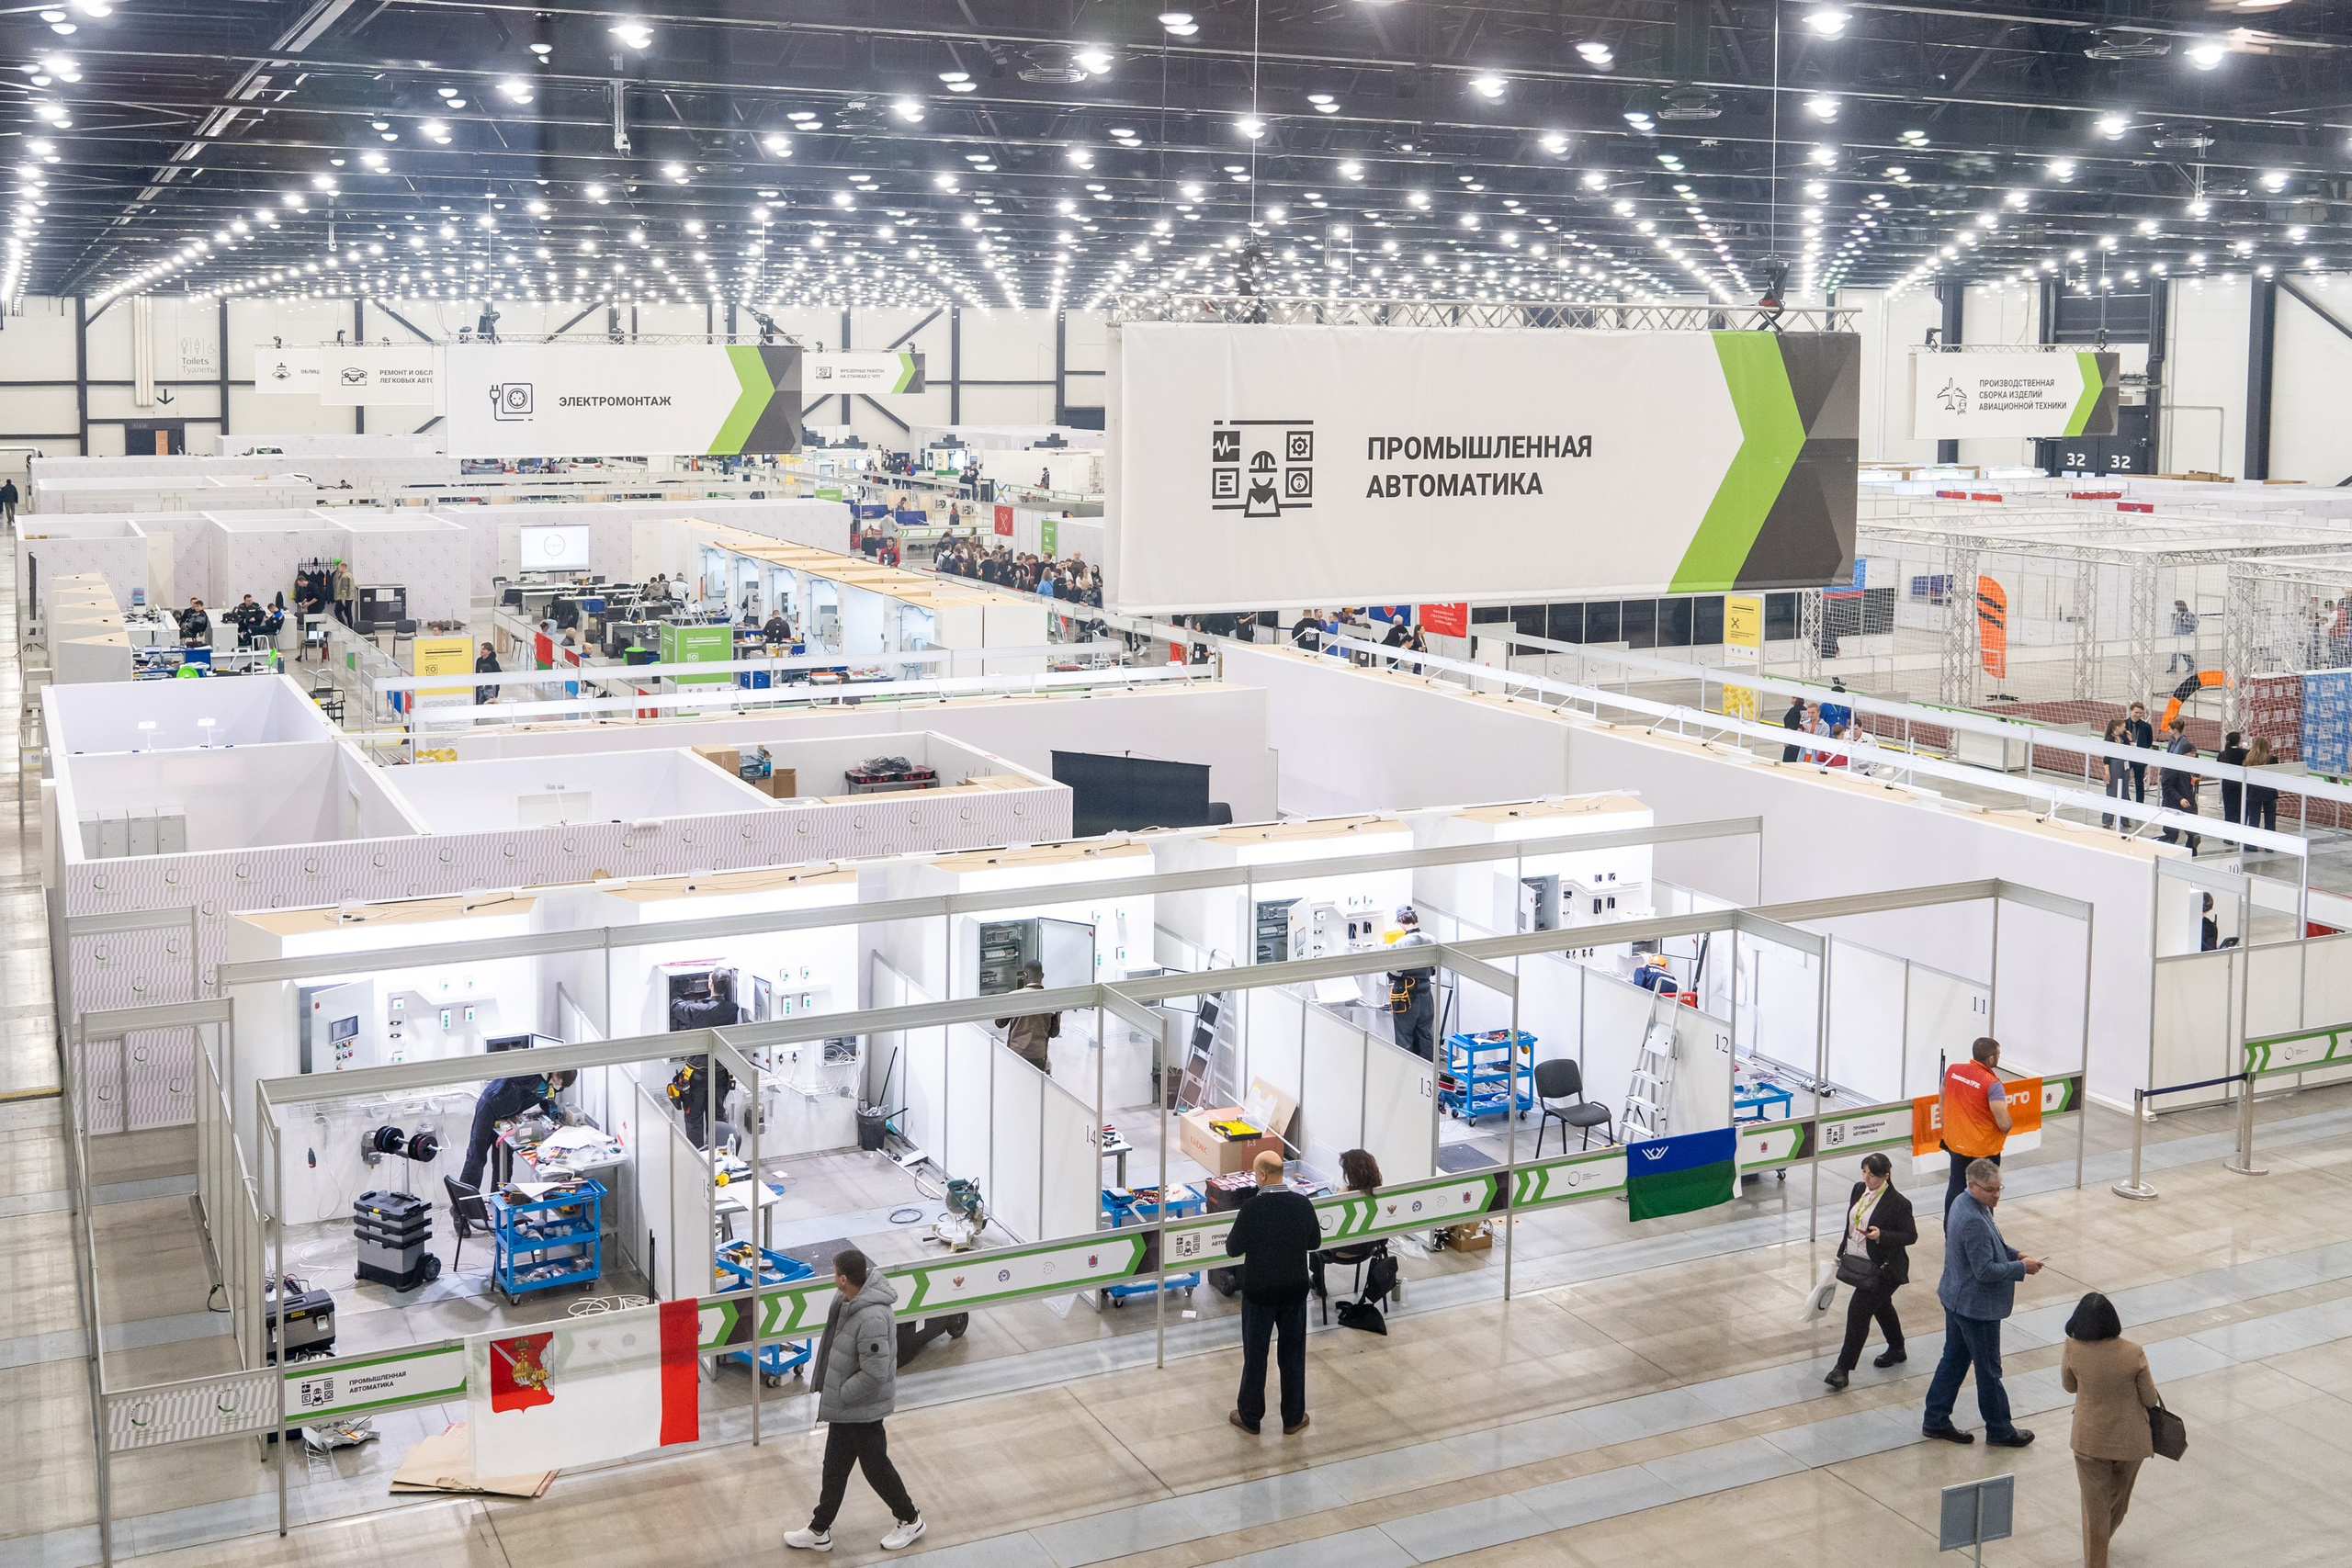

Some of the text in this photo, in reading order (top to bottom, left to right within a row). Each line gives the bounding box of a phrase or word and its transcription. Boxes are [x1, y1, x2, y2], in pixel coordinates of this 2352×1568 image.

[182, 366, 218, 375] Туалеты
[1979, 379, 2054, 388] ПРОИЗВОДСТВЕННАЯ
[559, 396, 672, 407] ЭЛЕКТРОМОНТАЖ
[2008, 389, 2042, 400] ИЗДЕЛИЙ
[1979, 400, 2067, 412] АВИАЦИОННОЙ ТЕХНИКИ
[1367, 434, 1593, 460] ПРОМЫШЛЕННАЯ
[2067, 453, 2086, 467] 32
[2110, 455, 2131, 469] 32
[1366, 472, 1544, 498] АВТОМАТИКА
[1715, 1034, 1729, 1054] 12
[1420, 1077, 1432, 1099] 13
[1852, 1122, 1886, 1131] ПРОМЫШЛЕННАЯ
[1086, 1125, 1096, 1148] 14
[349, 1371, 407, 1385] ПРОМЫШЛЕННАЯ
[349, 1381, 394, 1393] АВТОМАТИКА
